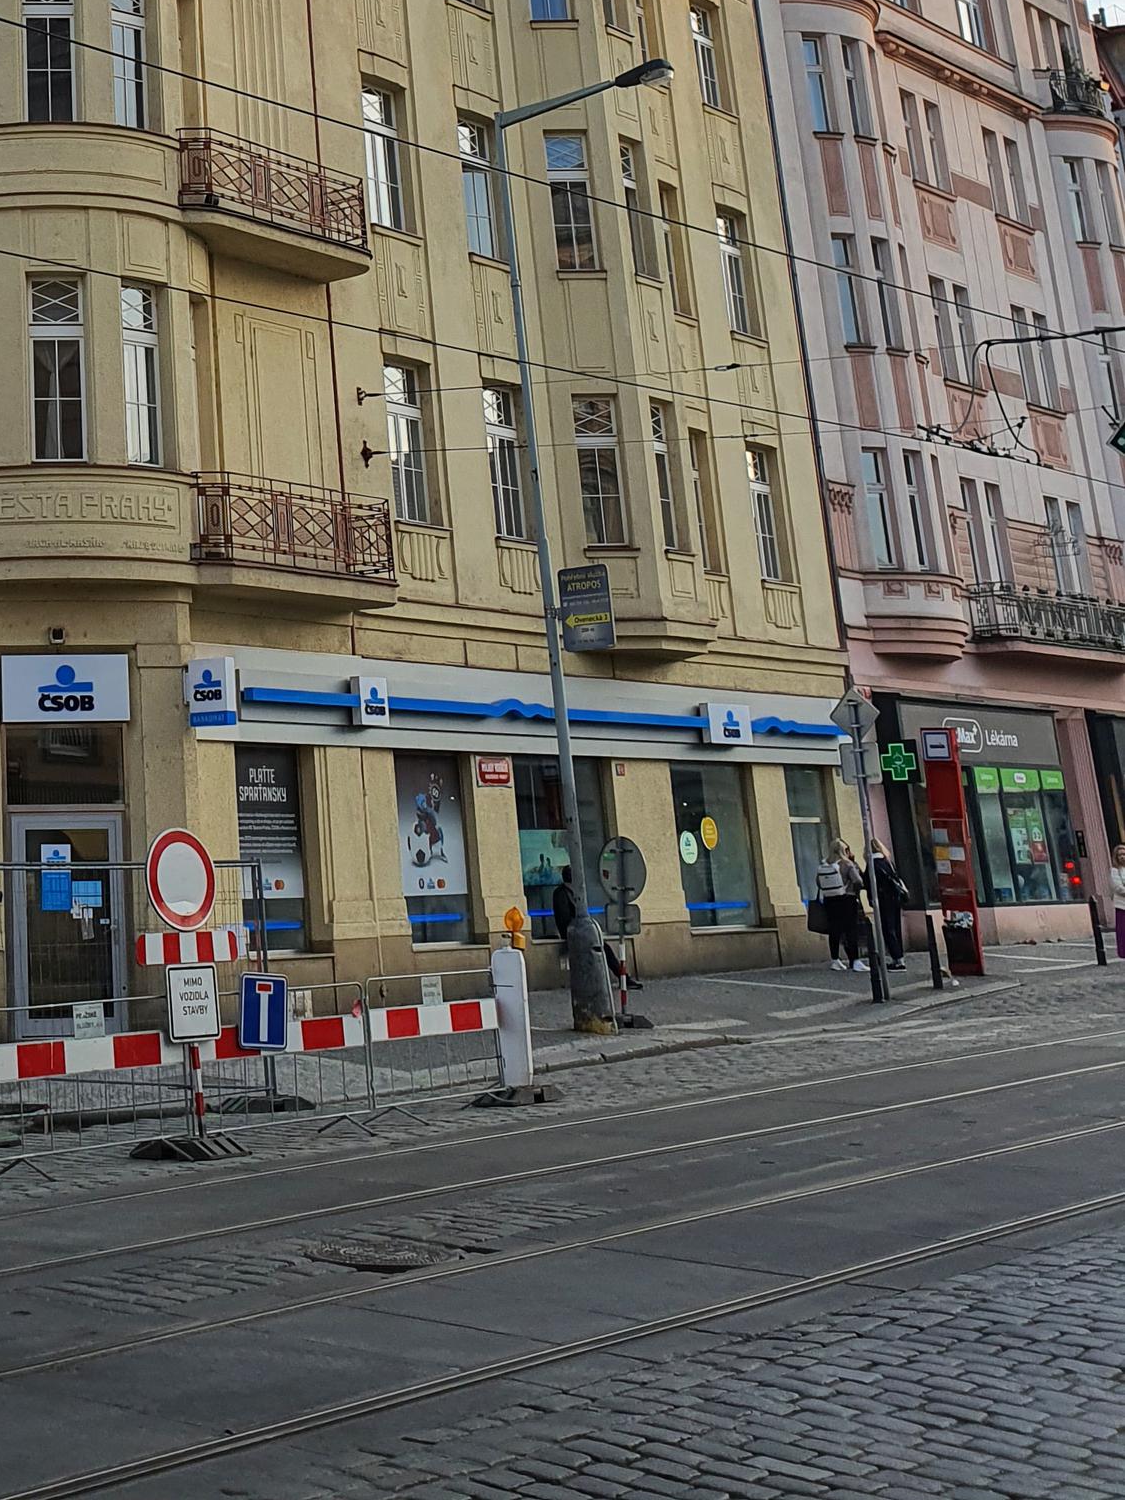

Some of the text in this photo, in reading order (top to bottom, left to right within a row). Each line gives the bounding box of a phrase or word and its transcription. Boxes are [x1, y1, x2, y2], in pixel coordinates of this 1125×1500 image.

[566, 580, 602, 592] ATROPOS
[193, 688, 222, 702] ČSOB
[38, 693, 95, 712] ČSOB
[984, 729, 1019, 747] Lékárna
[248, 765, 276, 784] PLAŤTE
[238, 784, 287, 802] SPARŤANSKY
[183, 976, 203, 987] MIMO
[178, 991, 209, 1002] VOZIDLA
[182, 1005, 209, 1016] STAVBY
